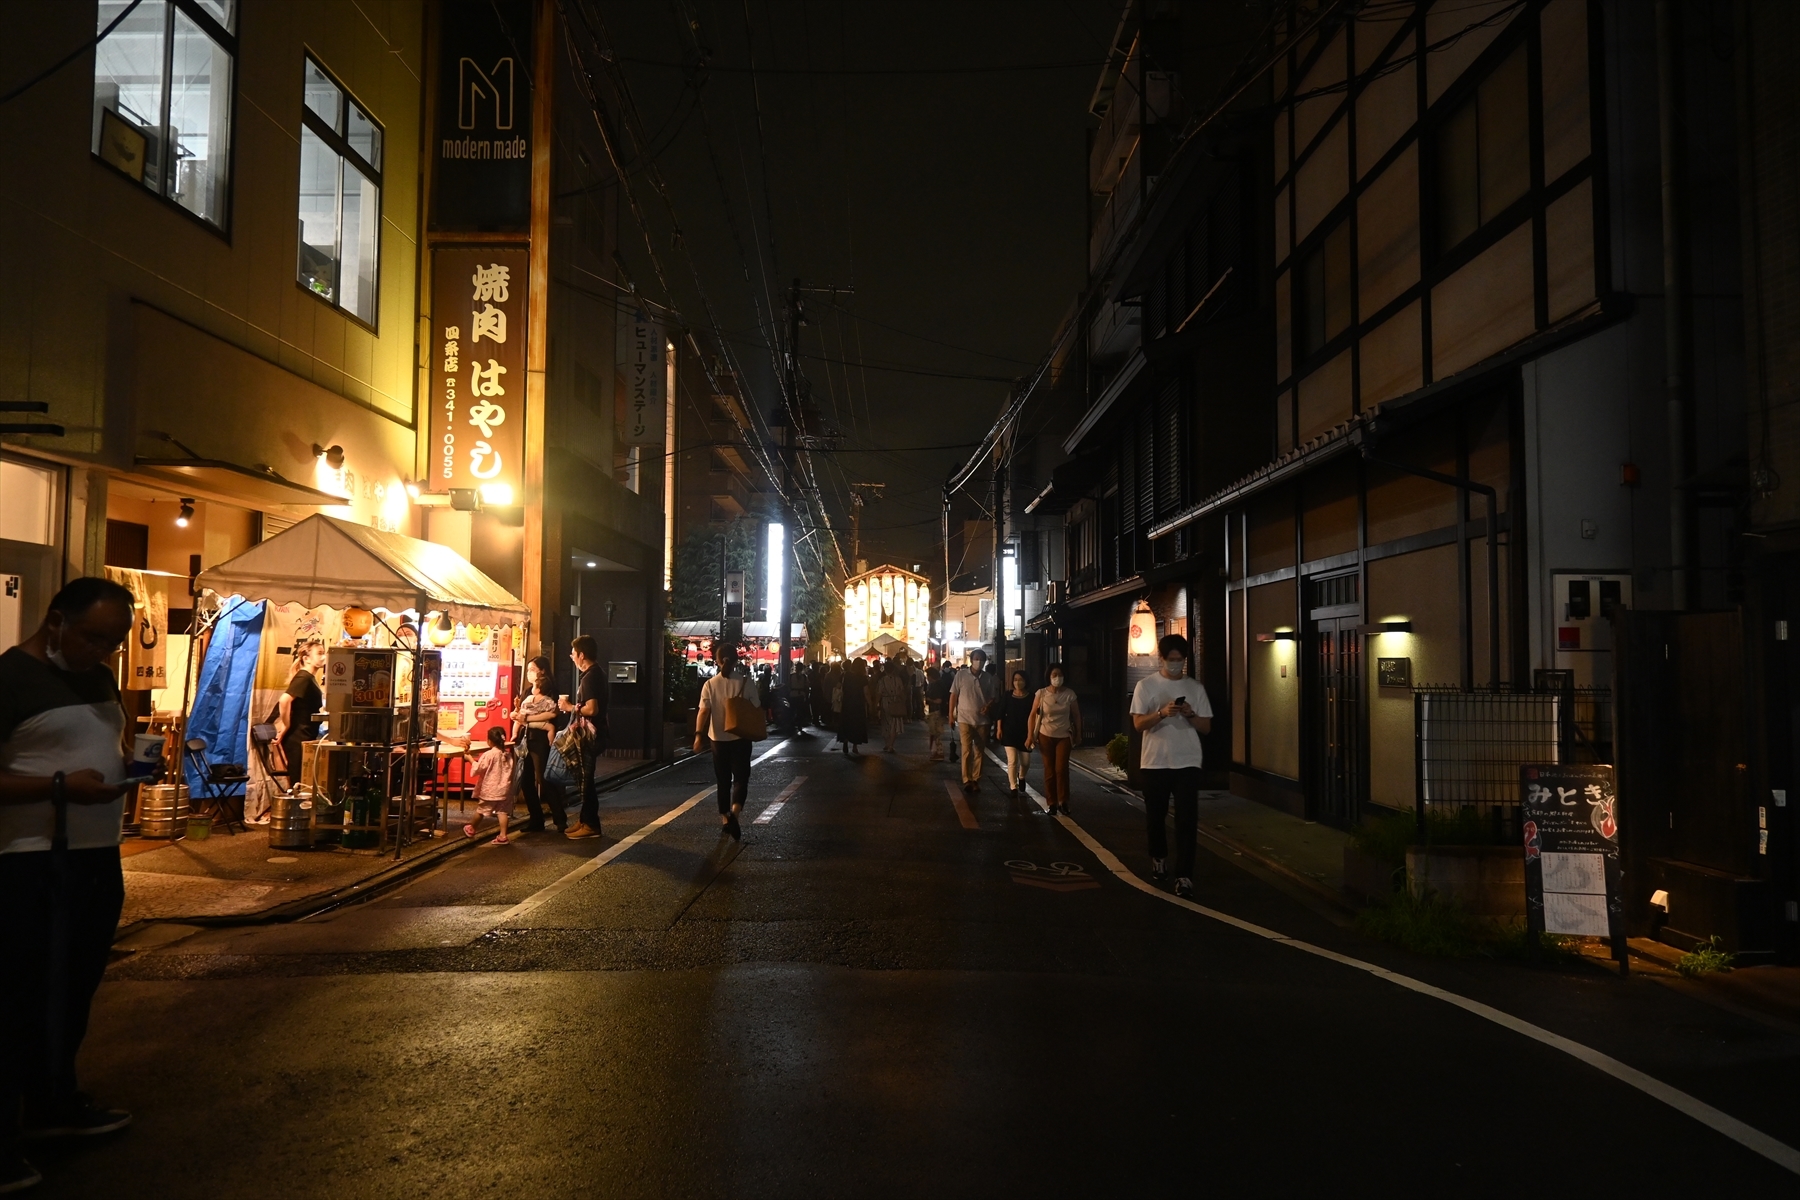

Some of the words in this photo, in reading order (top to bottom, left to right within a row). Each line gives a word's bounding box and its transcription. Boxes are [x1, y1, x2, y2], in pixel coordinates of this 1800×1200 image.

[442, 135, 491, 160] modern
[493, 135, 527, 160] made
[471, 262, 511, 344] 焼肉
[444, 325, 460, 373] 四条店
[633, 326, 647, 437] ヒューマンステージ
[468, 358, 507, 479] はやし
[136, 666, 165, 678] 四条店
[1527, 783, 1602, 807] みとき
